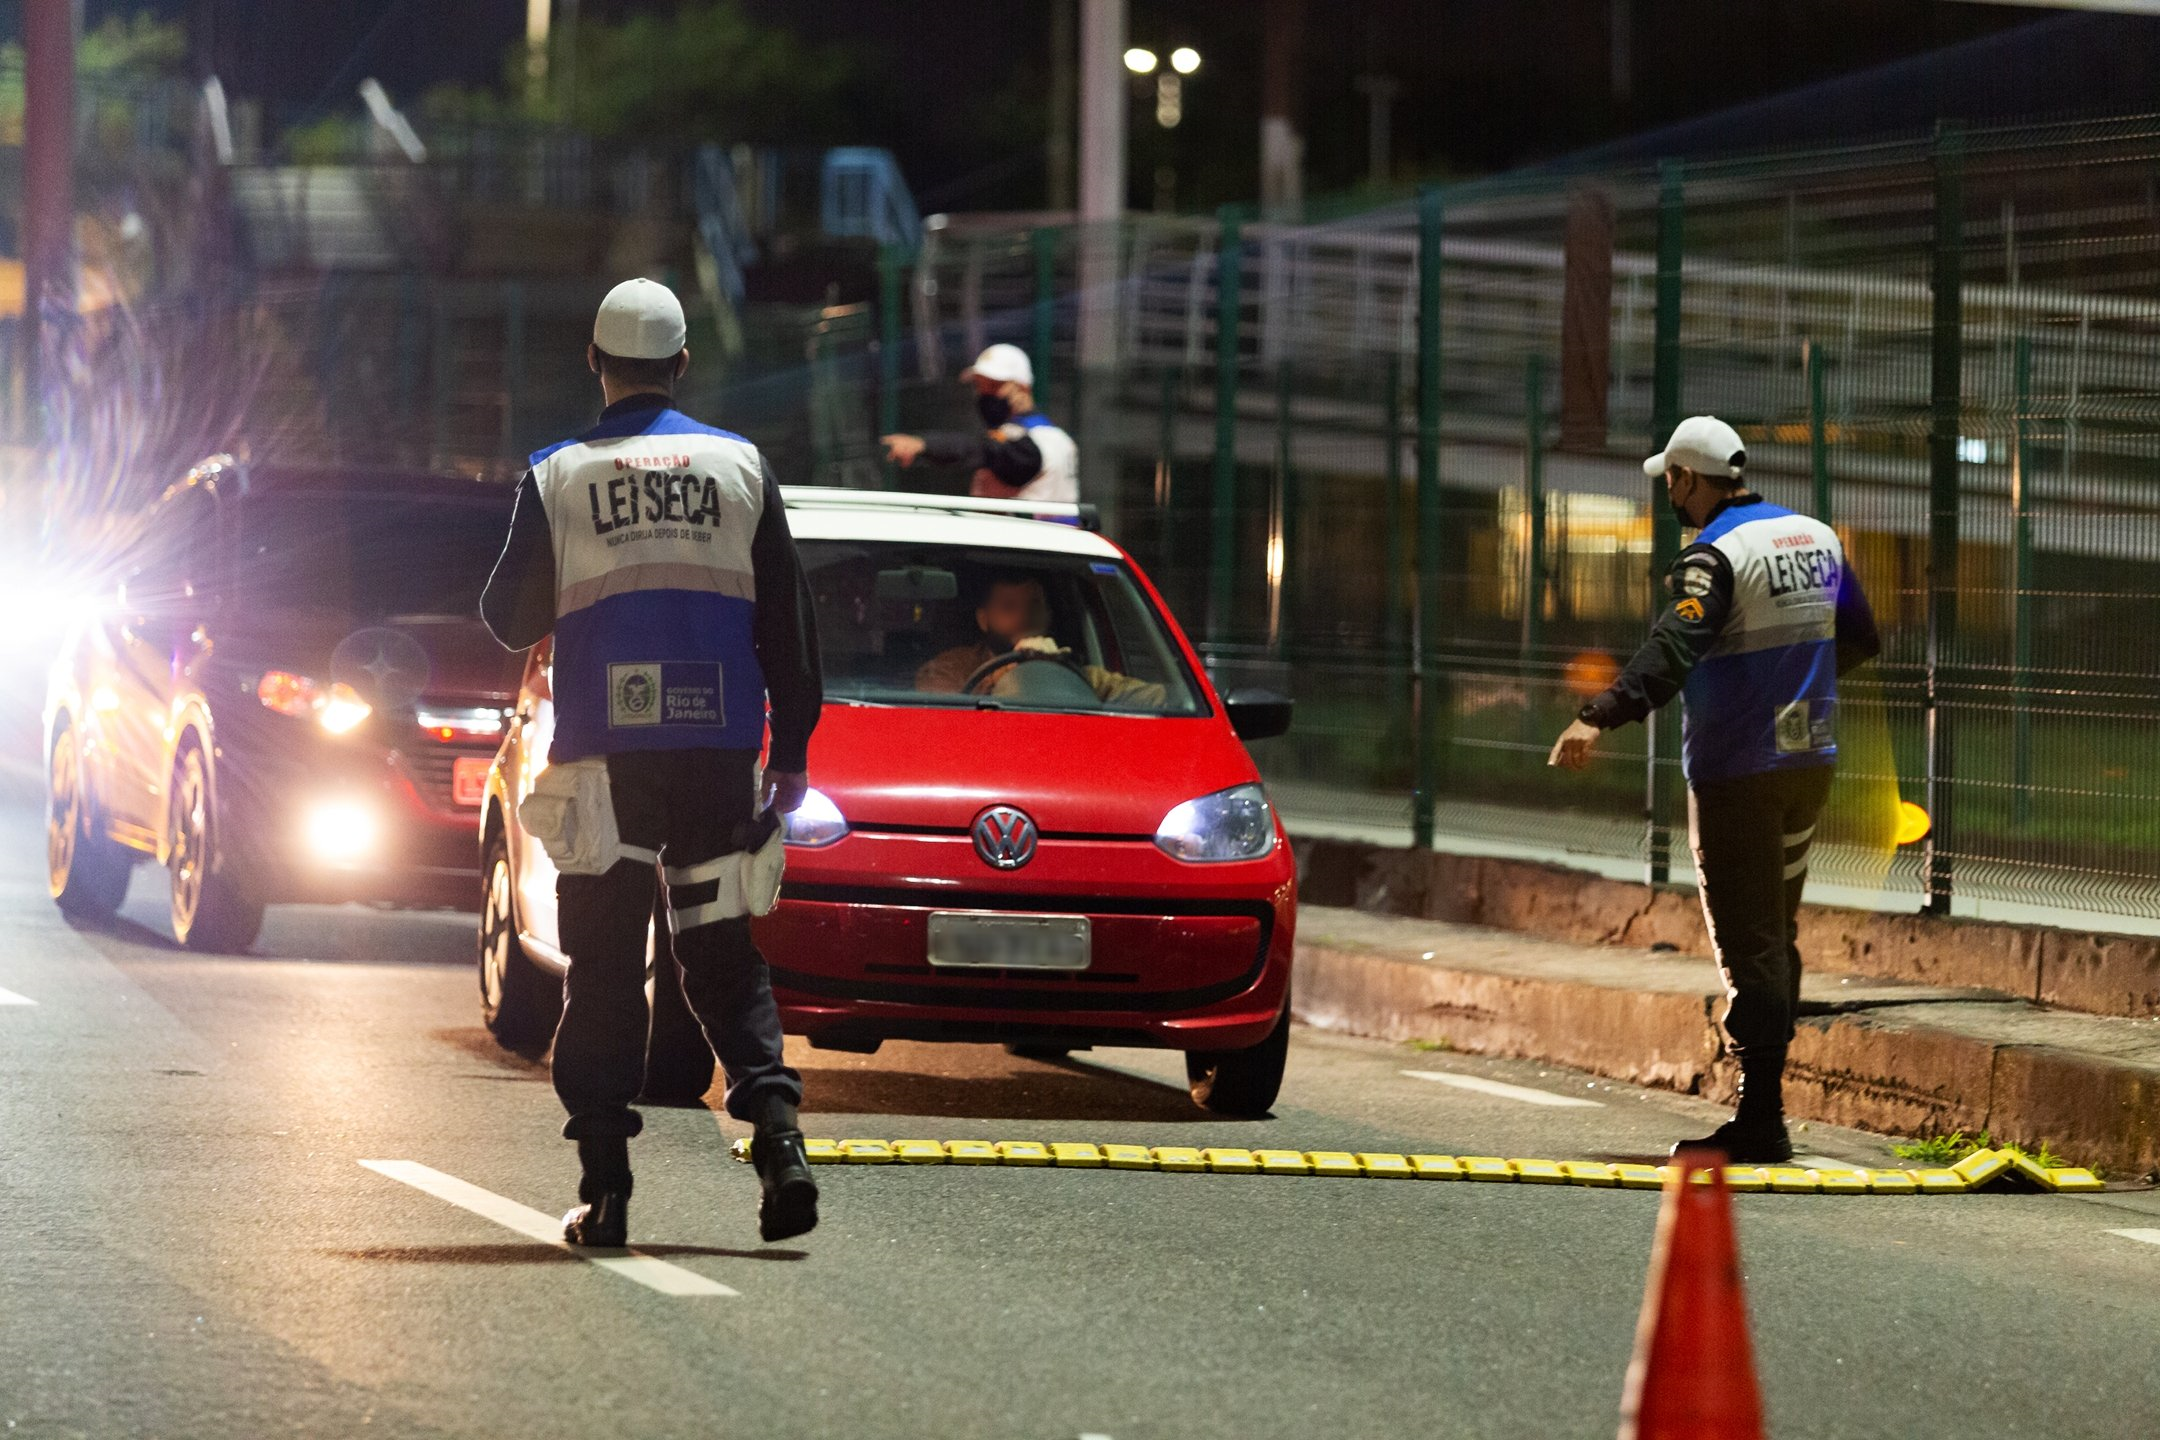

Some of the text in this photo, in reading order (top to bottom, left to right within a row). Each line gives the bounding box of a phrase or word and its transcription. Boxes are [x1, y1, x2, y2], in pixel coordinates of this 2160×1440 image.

[614, 453, 690, 470] OPERAÇÃO
[643, 470, 721, 527] SECA
[654, 528, 678, 540] DEPOIS
[680, 529, 690, 540] DE
[1795, 549, 1838, 590] SECA
[666, 695, 706, 708] Rio de
[666, 708, 717, 720] Janeiro
